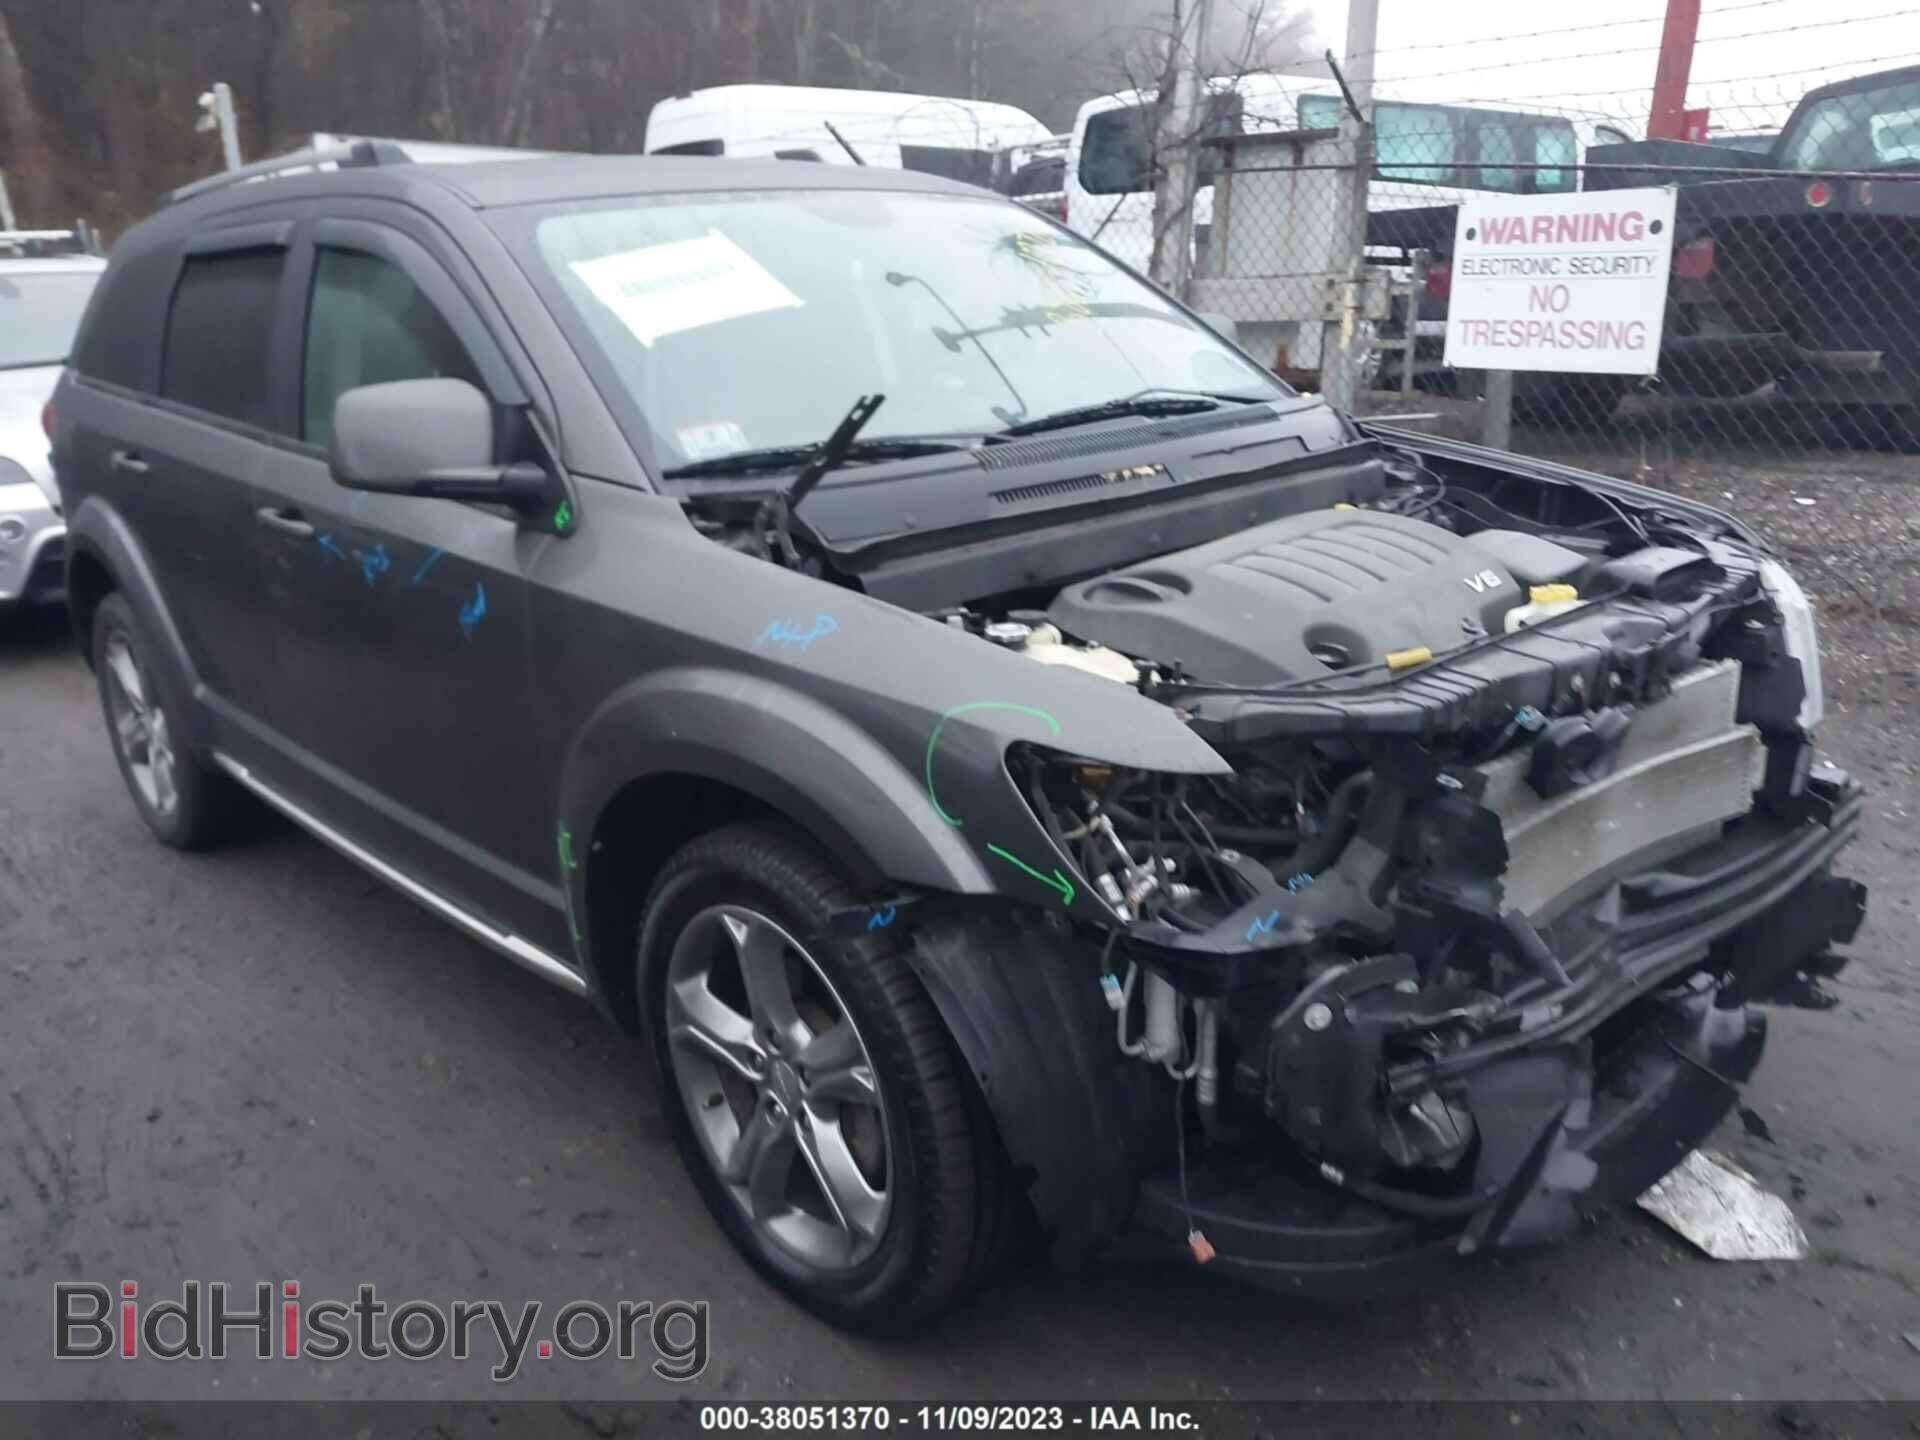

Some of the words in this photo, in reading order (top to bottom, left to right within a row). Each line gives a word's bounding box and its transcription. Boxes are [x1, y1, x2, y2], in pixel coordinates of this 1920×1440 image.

[1478, 211, 1645, 245] WARNING
[1461, 257, 1561, 276] ELECTRONIC
[1568, 255, 1657, 276] SECURITY
[1528, 284, 1571, 313] NO
[1459, 319, 1649, 350] TRESPASSING
[1463, 569, 1503, 593] V6
